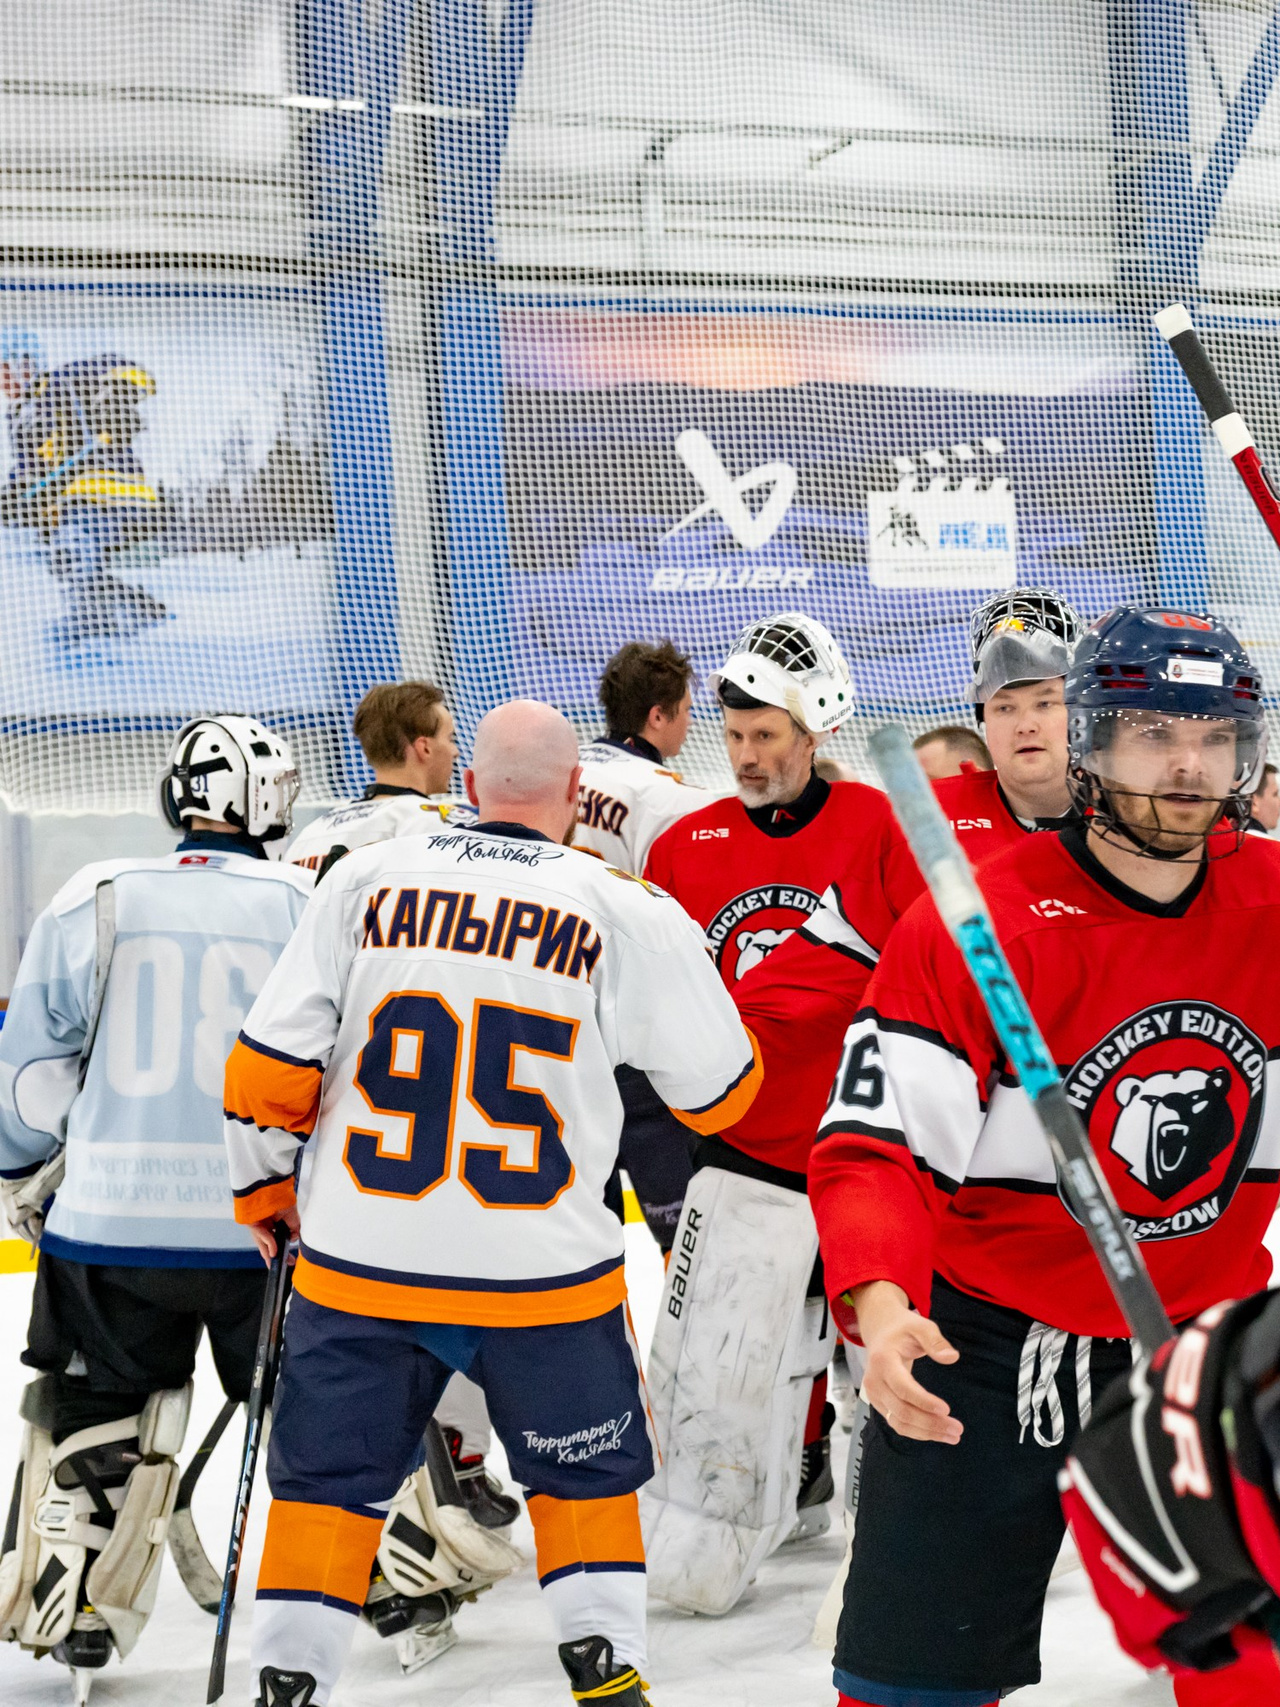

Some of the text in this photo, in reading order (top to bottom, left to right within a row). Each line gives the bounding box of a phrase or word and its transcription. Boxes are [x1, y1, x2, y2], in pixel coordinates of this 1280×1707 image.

[650, 567, 815, 591] BAUER
[457, 841, 564, 867] Хомяков
[828, 1032, 886, 1110] 6
[1065, 1009, 1266, 1111] HOCKEY EDITION
[342, 989, 581, 1211] 95
[1118, 1196, 1220, 1240] OSCOW
[668, 1207, 703, 1321] BAUER
[522, 1419, 616, 1454] Территория
[557, 1411, 632, 1464] Хомяков
